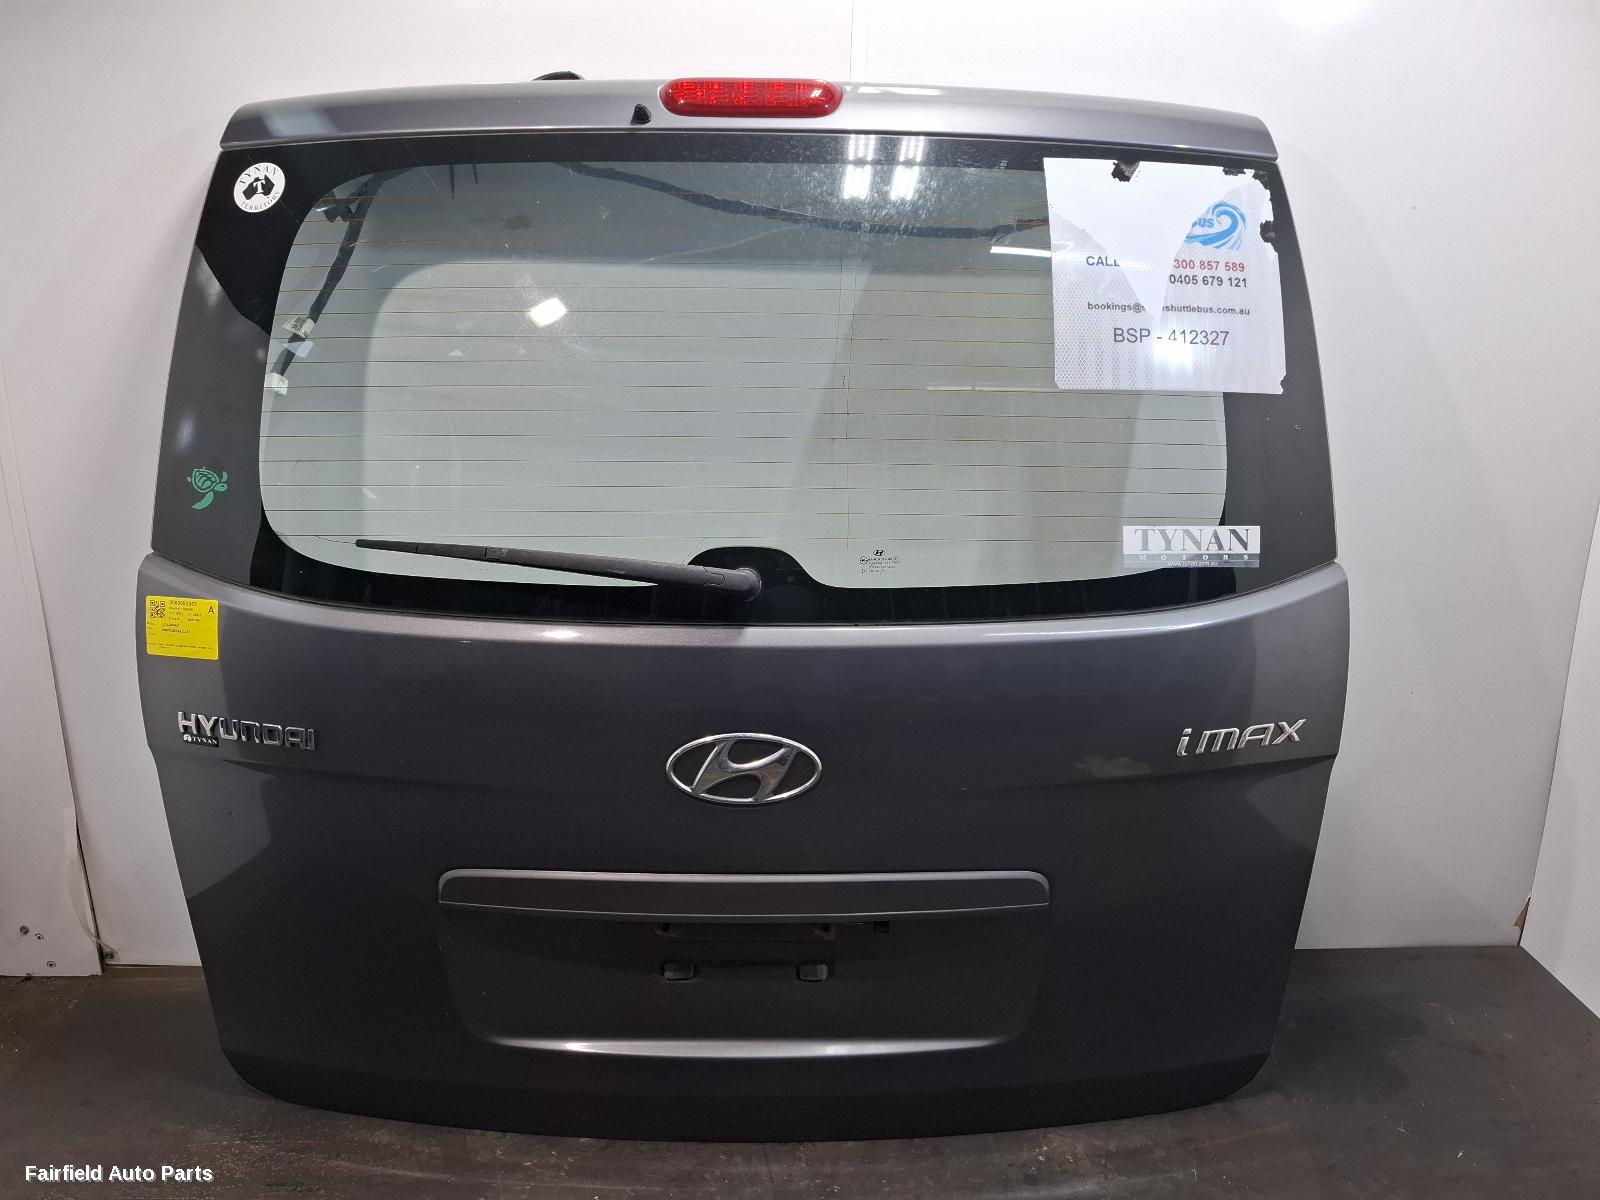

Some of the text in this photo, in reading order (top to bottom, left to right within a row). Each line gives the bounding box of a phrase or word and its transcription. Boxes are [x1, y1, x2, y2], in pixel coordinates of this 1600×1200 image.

[238, 164, 278, 186] TYNAN
[1086, 256, 1120, 267] CALL
[1199, 260, 1219, 271] 857
[1224, 262, 1245, 272] 589
[1169, 274, 1247, 288] 0405 679 121
[1113, 328, 1151, 343] BSP
[1168, 329, 1230, 346] 412327
[1134, 528, 1250, 552] TYNAN
[208, 606, 215, 615] A
[177, 711, 316, 750] HYUNDAI
[192, 736, 219, 745] TYNAN
